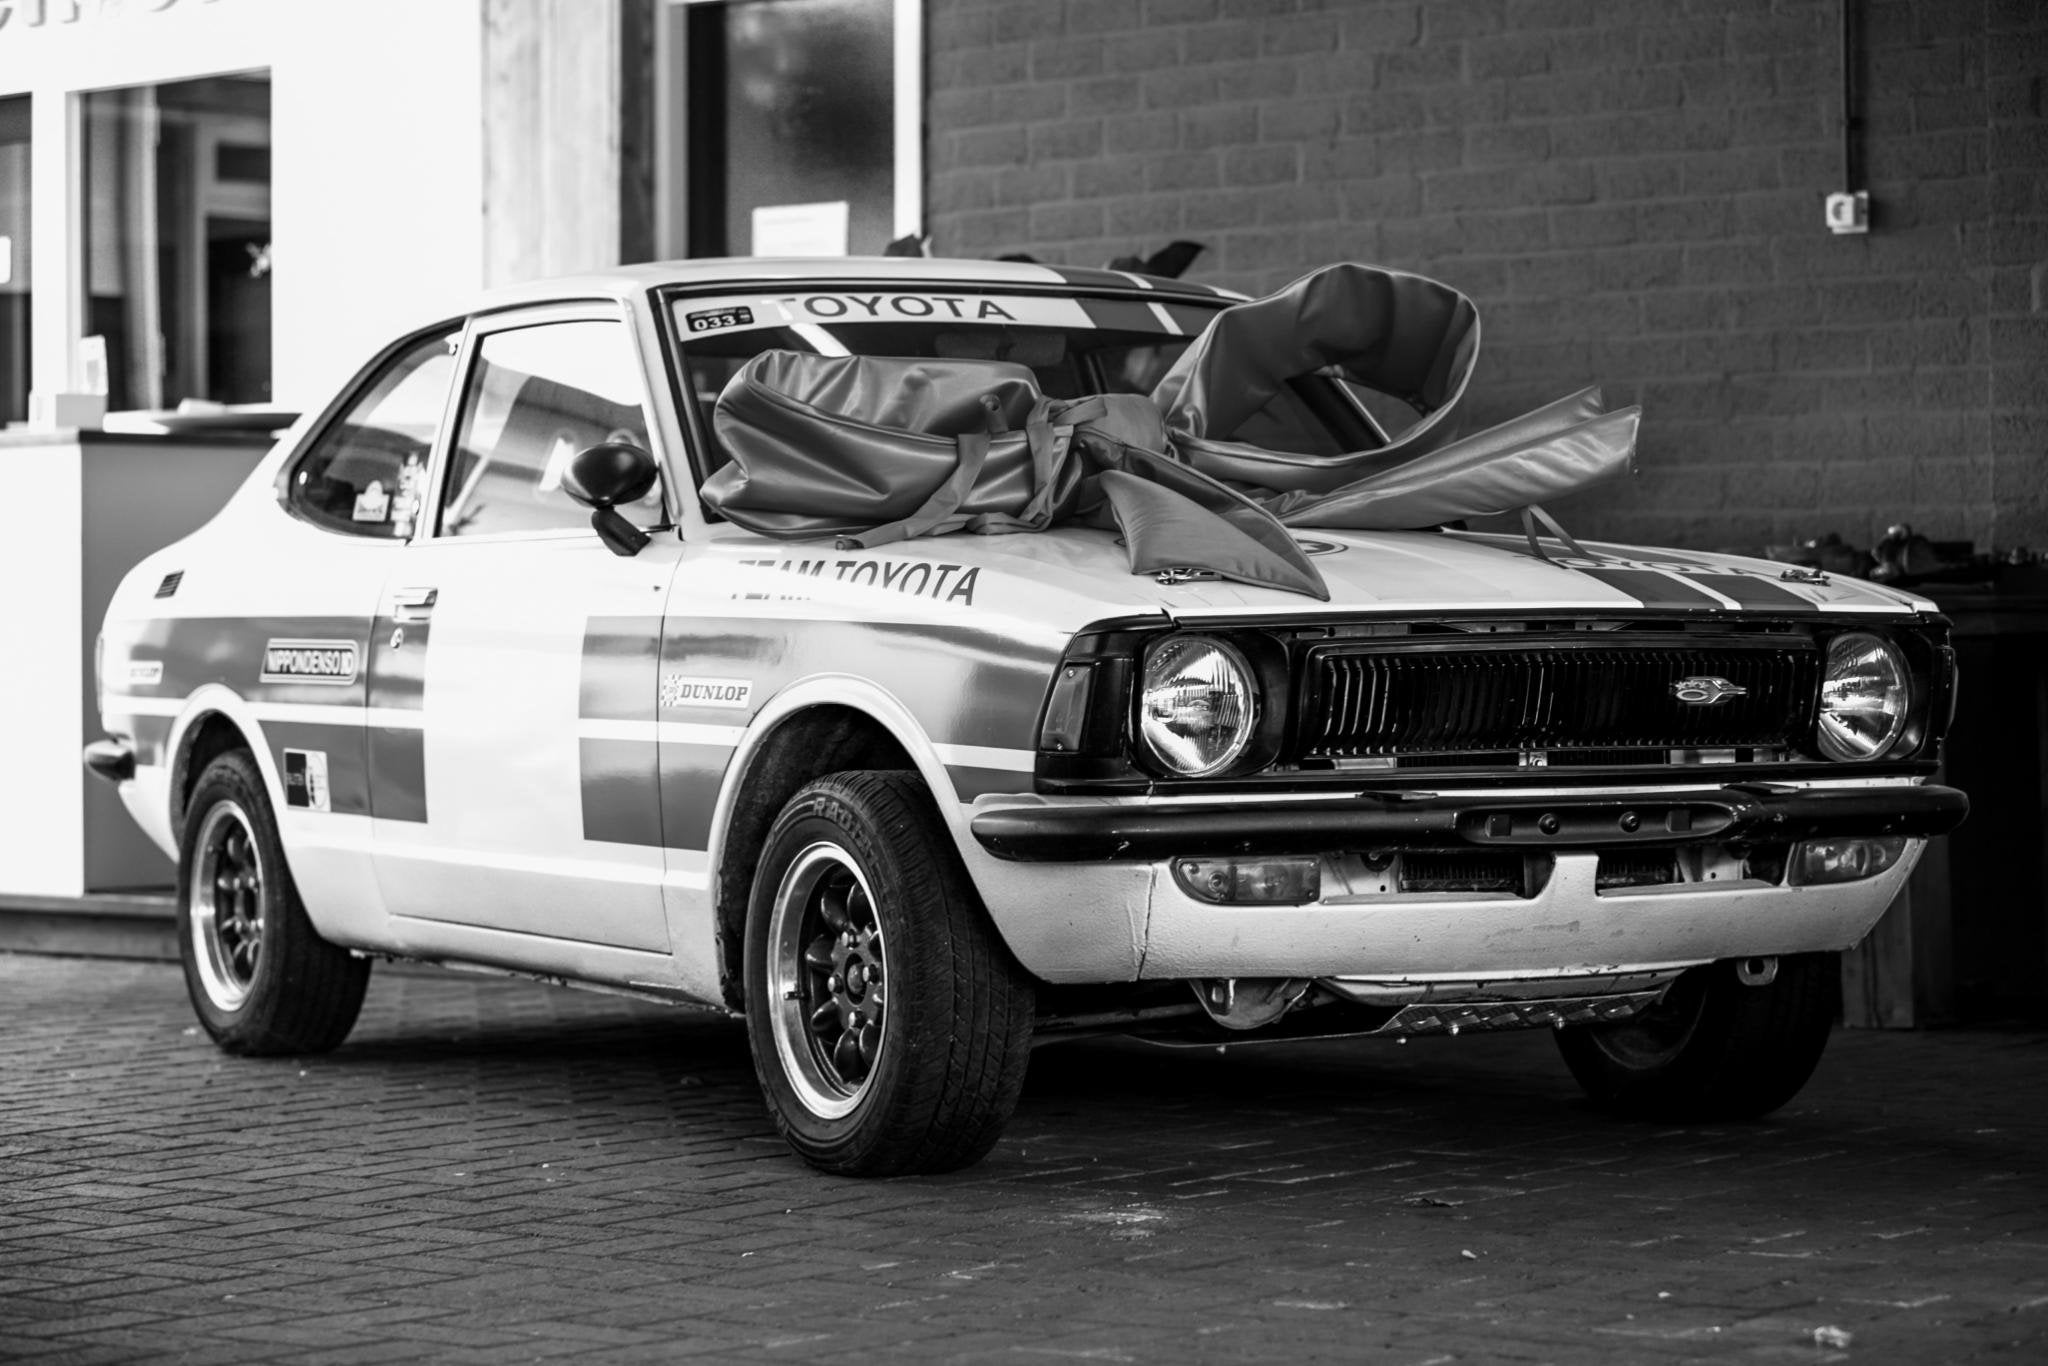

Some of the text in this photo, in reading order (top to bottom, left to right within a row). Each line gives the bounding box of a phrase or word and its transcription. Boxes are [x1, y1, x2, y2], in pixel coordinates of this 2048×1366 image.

[693, 315, 736, 331] 033
[835, 560, 981, 607] TOYOTA
[680, 684, 748, 701] DUNLOP
